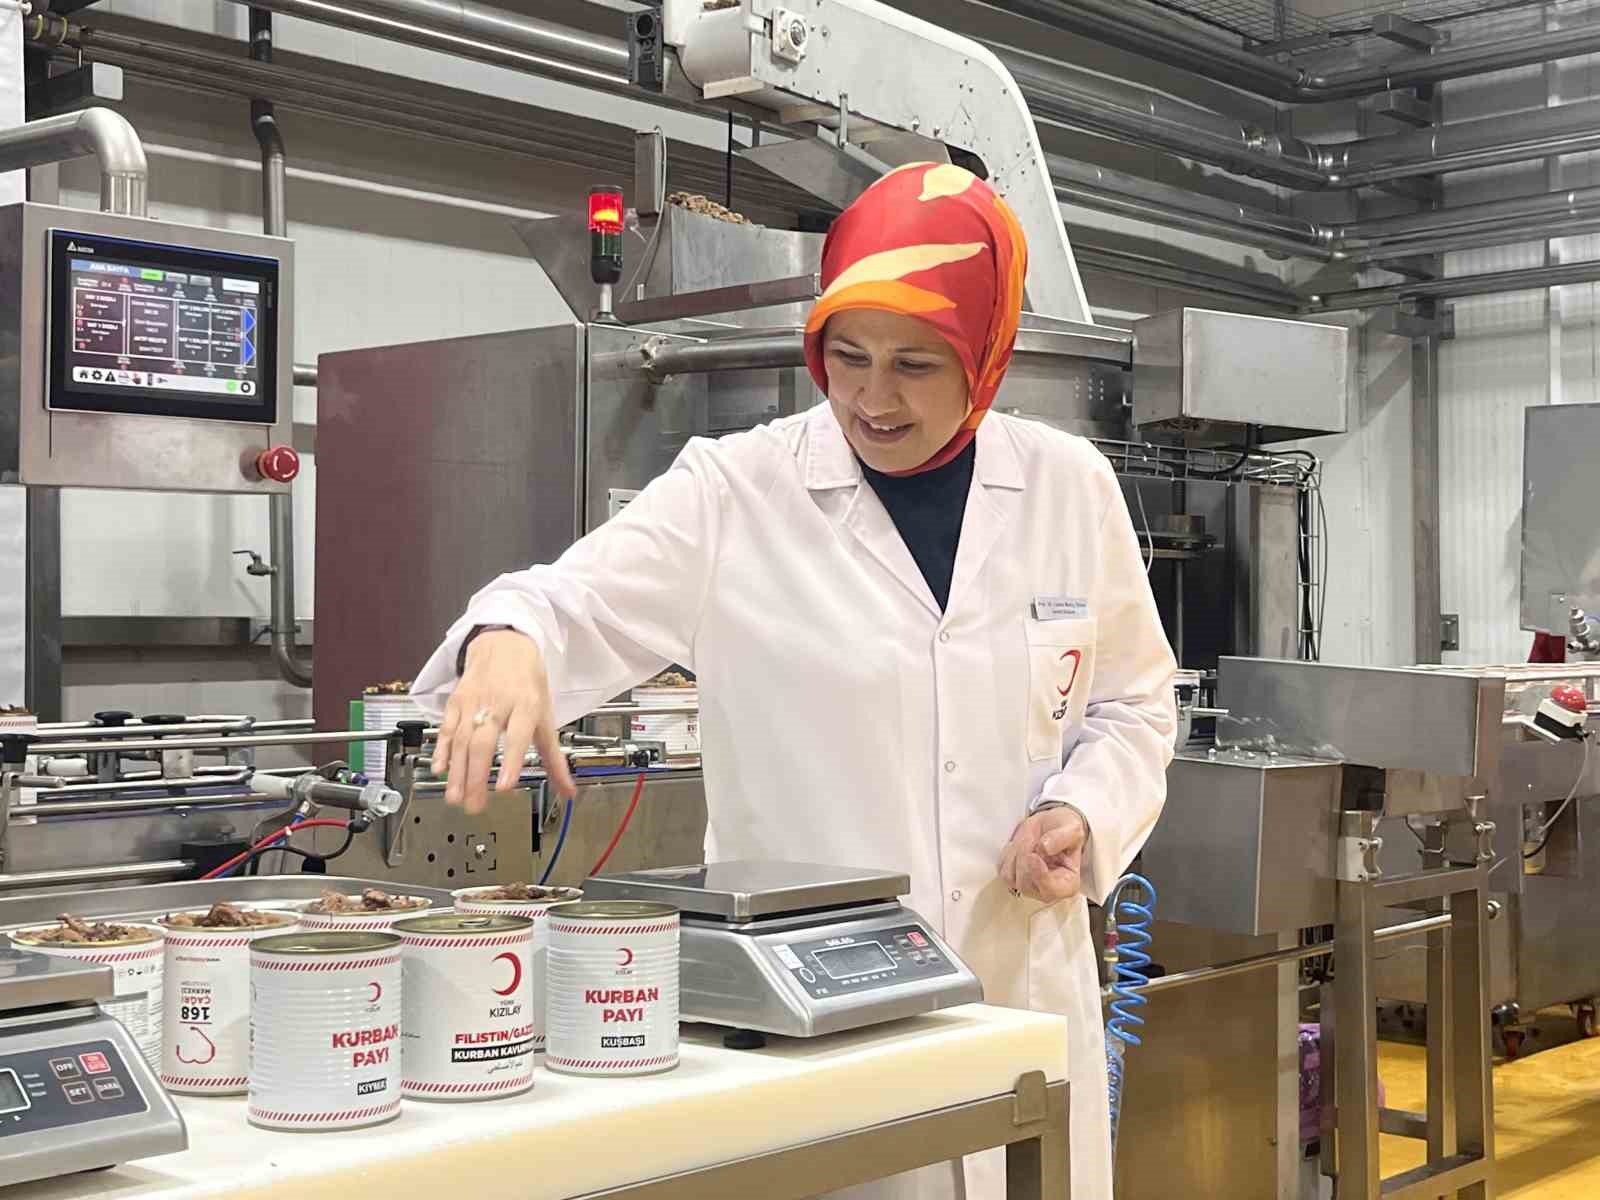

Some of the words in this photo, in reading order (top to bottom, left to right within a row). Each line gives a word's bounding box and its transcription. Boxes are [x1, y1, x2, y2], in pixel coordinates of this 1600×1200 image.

[584, 988, 659, 1004] KURBAN
[181, 1006, 210, 1020] 168
[489, 1004, 522, 1018] KIZILAY
[603, 1008, 643, 1023] PAYI
[331, 1024, 399, 1048] KURBAN
[352, 1047, 389, 1068] PAYI
[454, 1047, 500, 1060] KURBAN
[56, 1063, 74, 1072] OFF
[69, 1087, 87, 1097] SET
